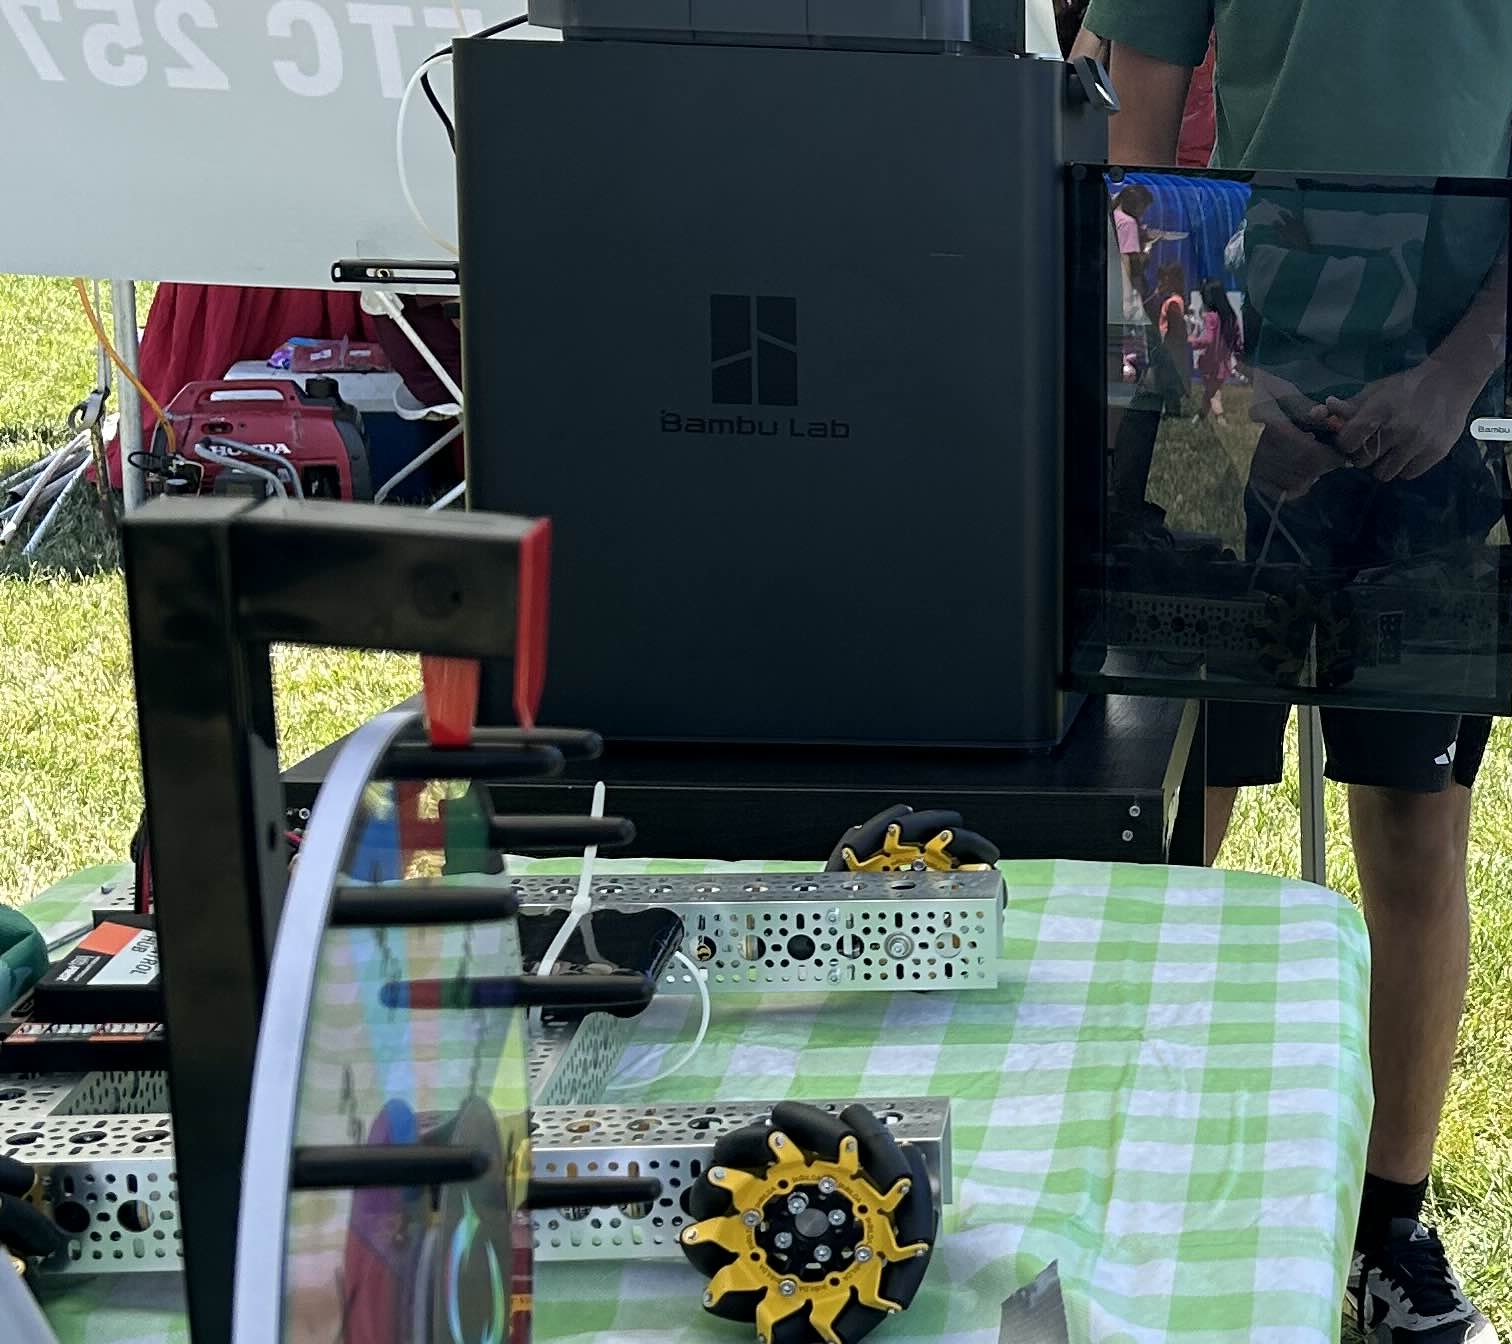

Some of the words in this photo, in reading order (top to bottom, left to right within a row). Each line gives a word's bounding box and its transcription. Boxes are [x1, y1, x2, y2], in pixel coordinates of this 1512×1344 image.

[661, 410, 778, 436] Bambu
[789, 418, 850, 439] Lab
[1478, 425, 1511, 434] Bambu
